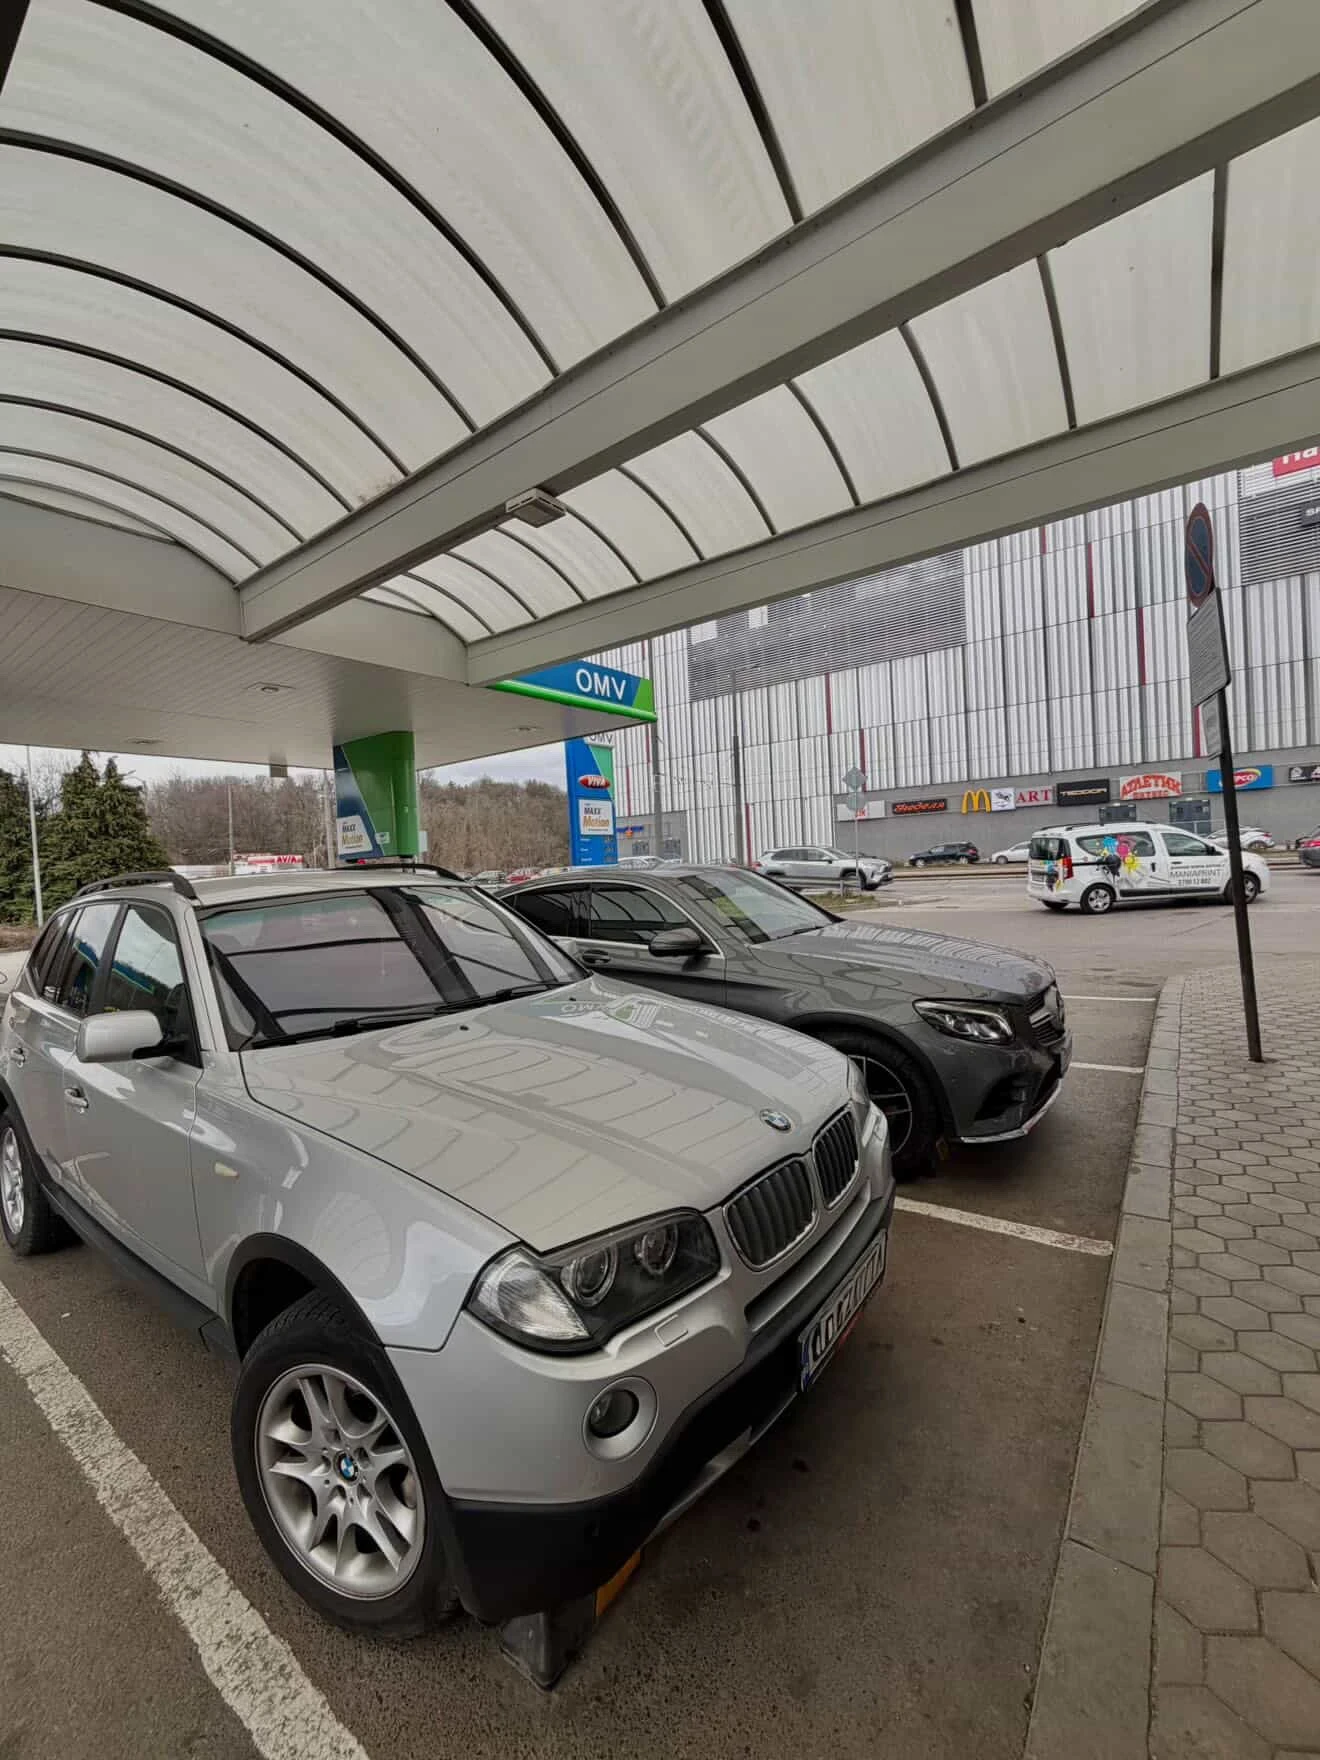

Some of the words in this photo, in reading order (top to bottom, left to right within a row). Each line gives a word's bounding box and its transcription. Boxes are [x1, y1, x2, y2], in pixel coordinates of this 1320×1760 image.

[576, 668, 626, 701] OMV
[587, 776, 607, 787] VIVA
[1017, 789, 1052, 803] ART
